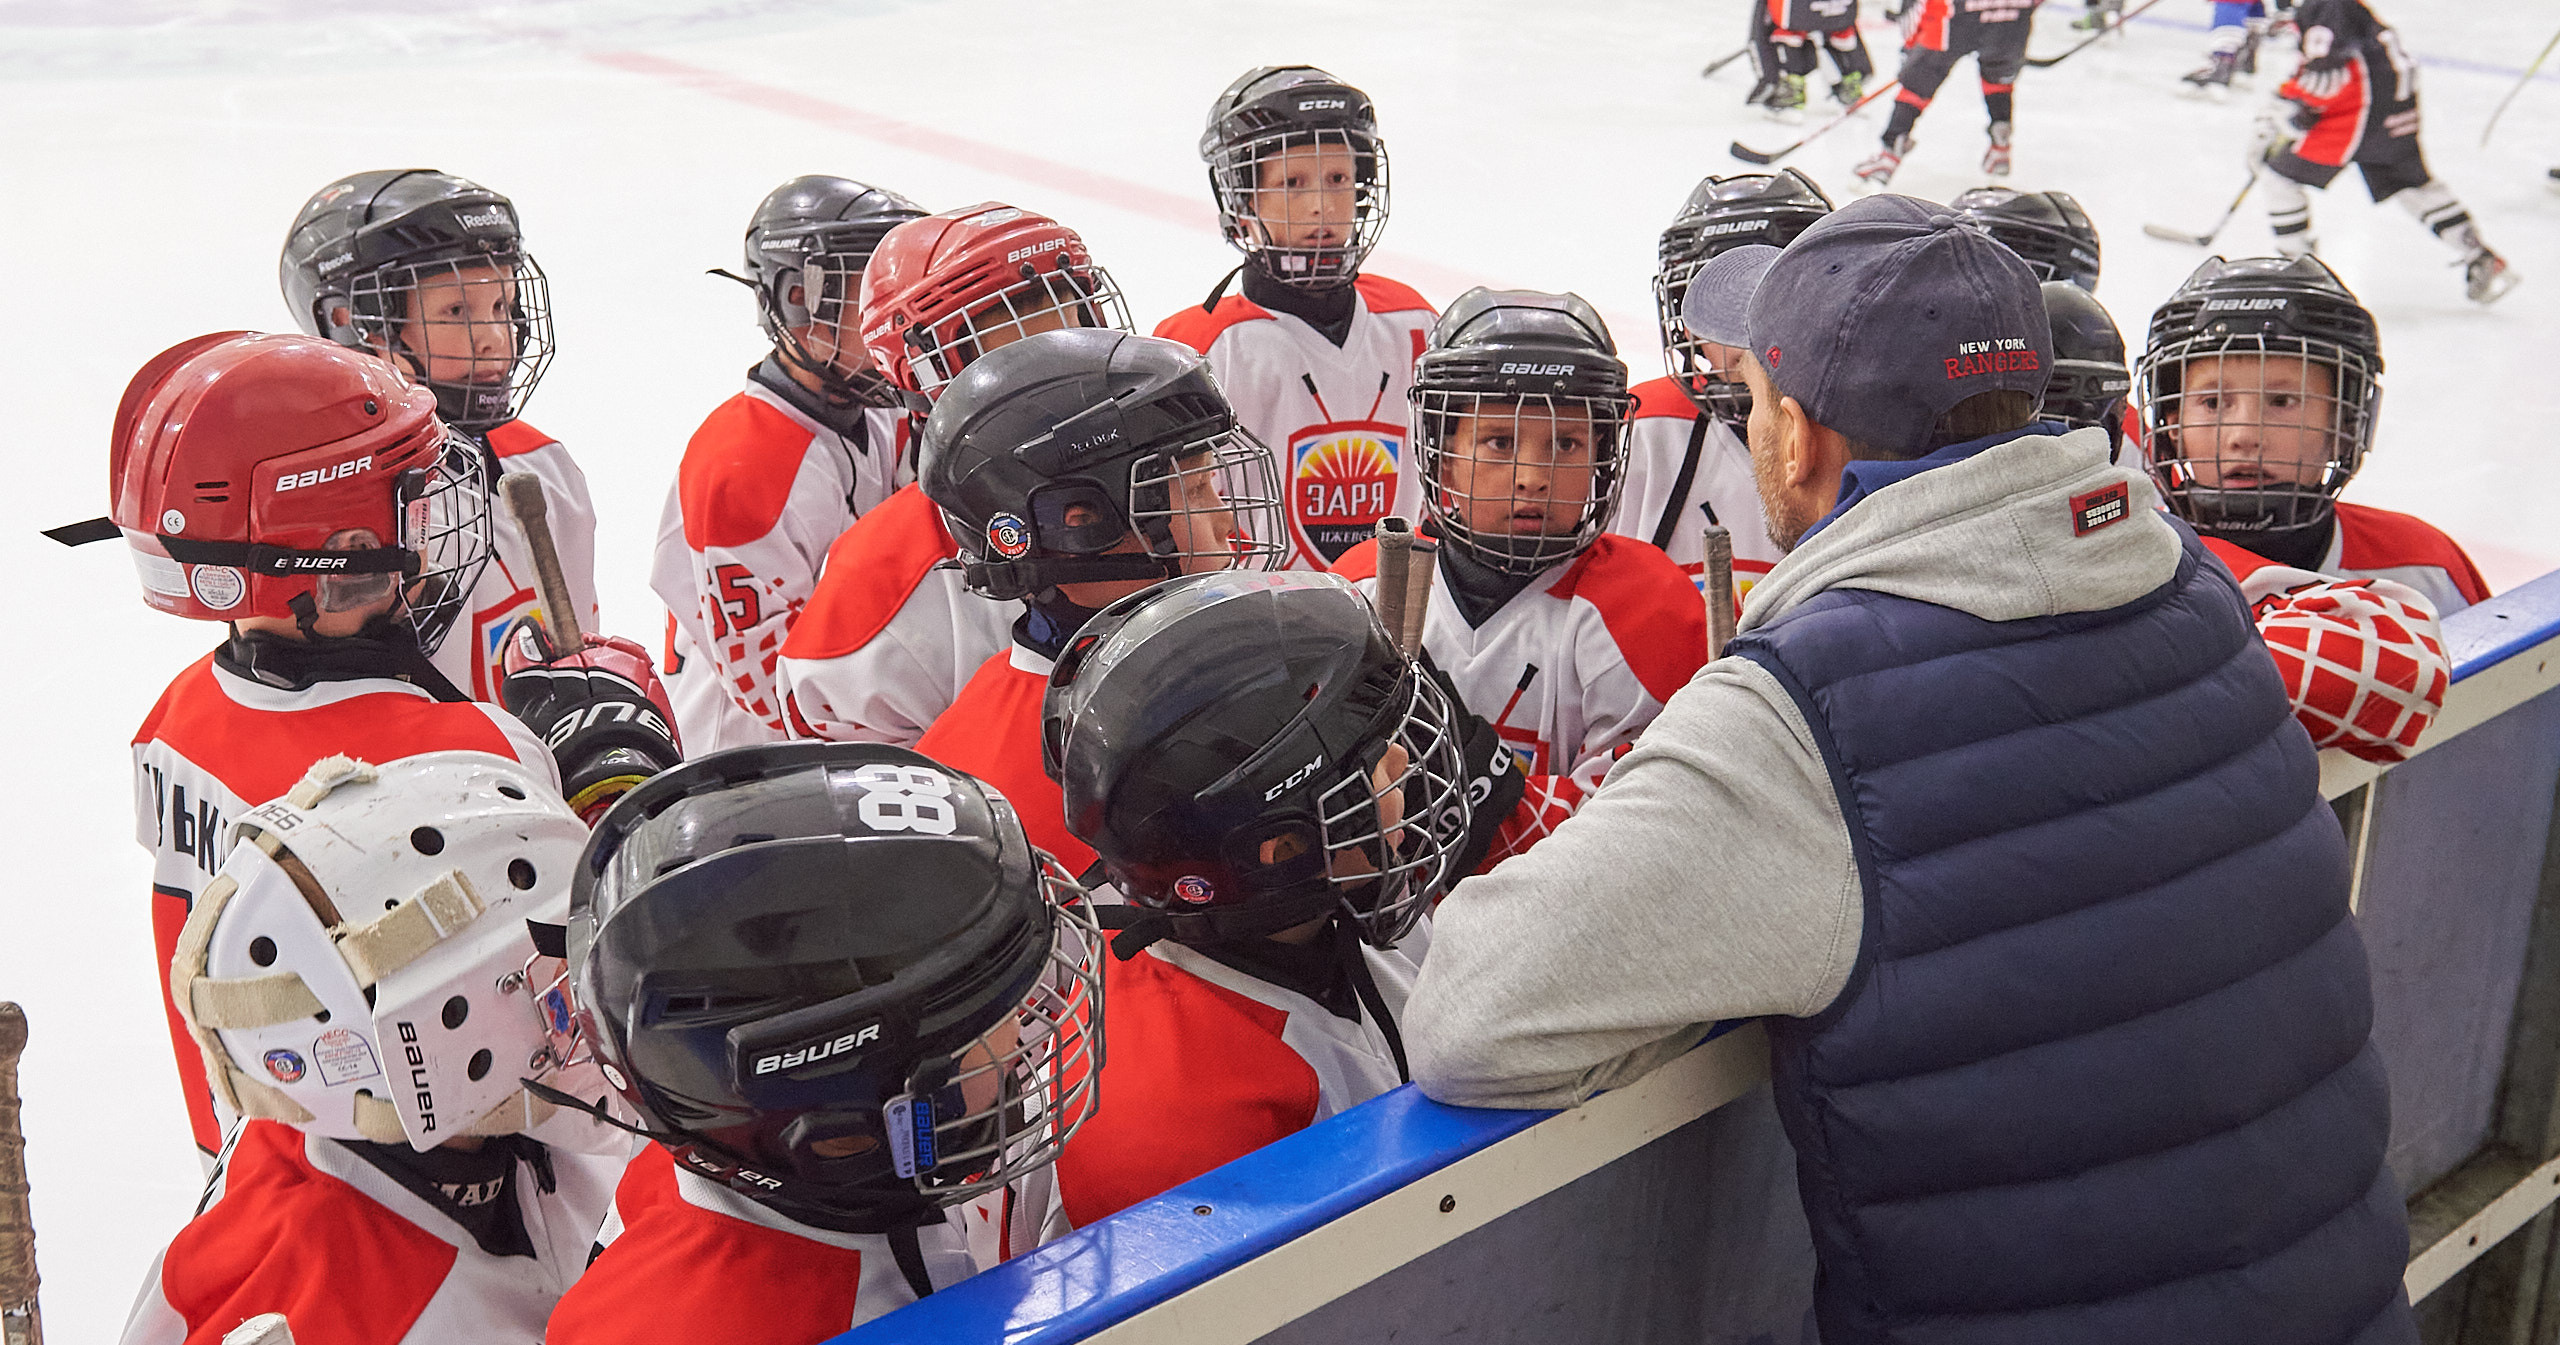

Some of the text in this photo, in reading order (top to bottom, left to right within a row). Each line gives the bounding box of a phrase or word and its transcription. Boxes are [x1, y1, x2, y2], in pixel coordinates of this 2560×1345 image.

[1299, 99, 1346, 112] CCM
[1702, 219, 1769, 237] BAUER
[761, 238, 801, 250] BAUER
[1007, 237, 1066, 263] BAUER
[2207, 298, 2288, 311] BAUER
[863, 320, 892, 344] BAUER
[1959, 337, 2026, 355] NEW YORK
[1500, 362, 1575, 377] BAUER
[1943, 350, 2040, 380] RANGERS
[275, 455, 372, 492] BAUER
[1306, 481, 1385, 517] ЗАРЯ
[1264, 754, 1323, 802] CCM
[854, 763, 958, 836] 88
[755, 1023, 880, 1075] BAUER
[396, 1021, 437, 1134] BAUER
[915, 1102, 934, 1167] BAUER
